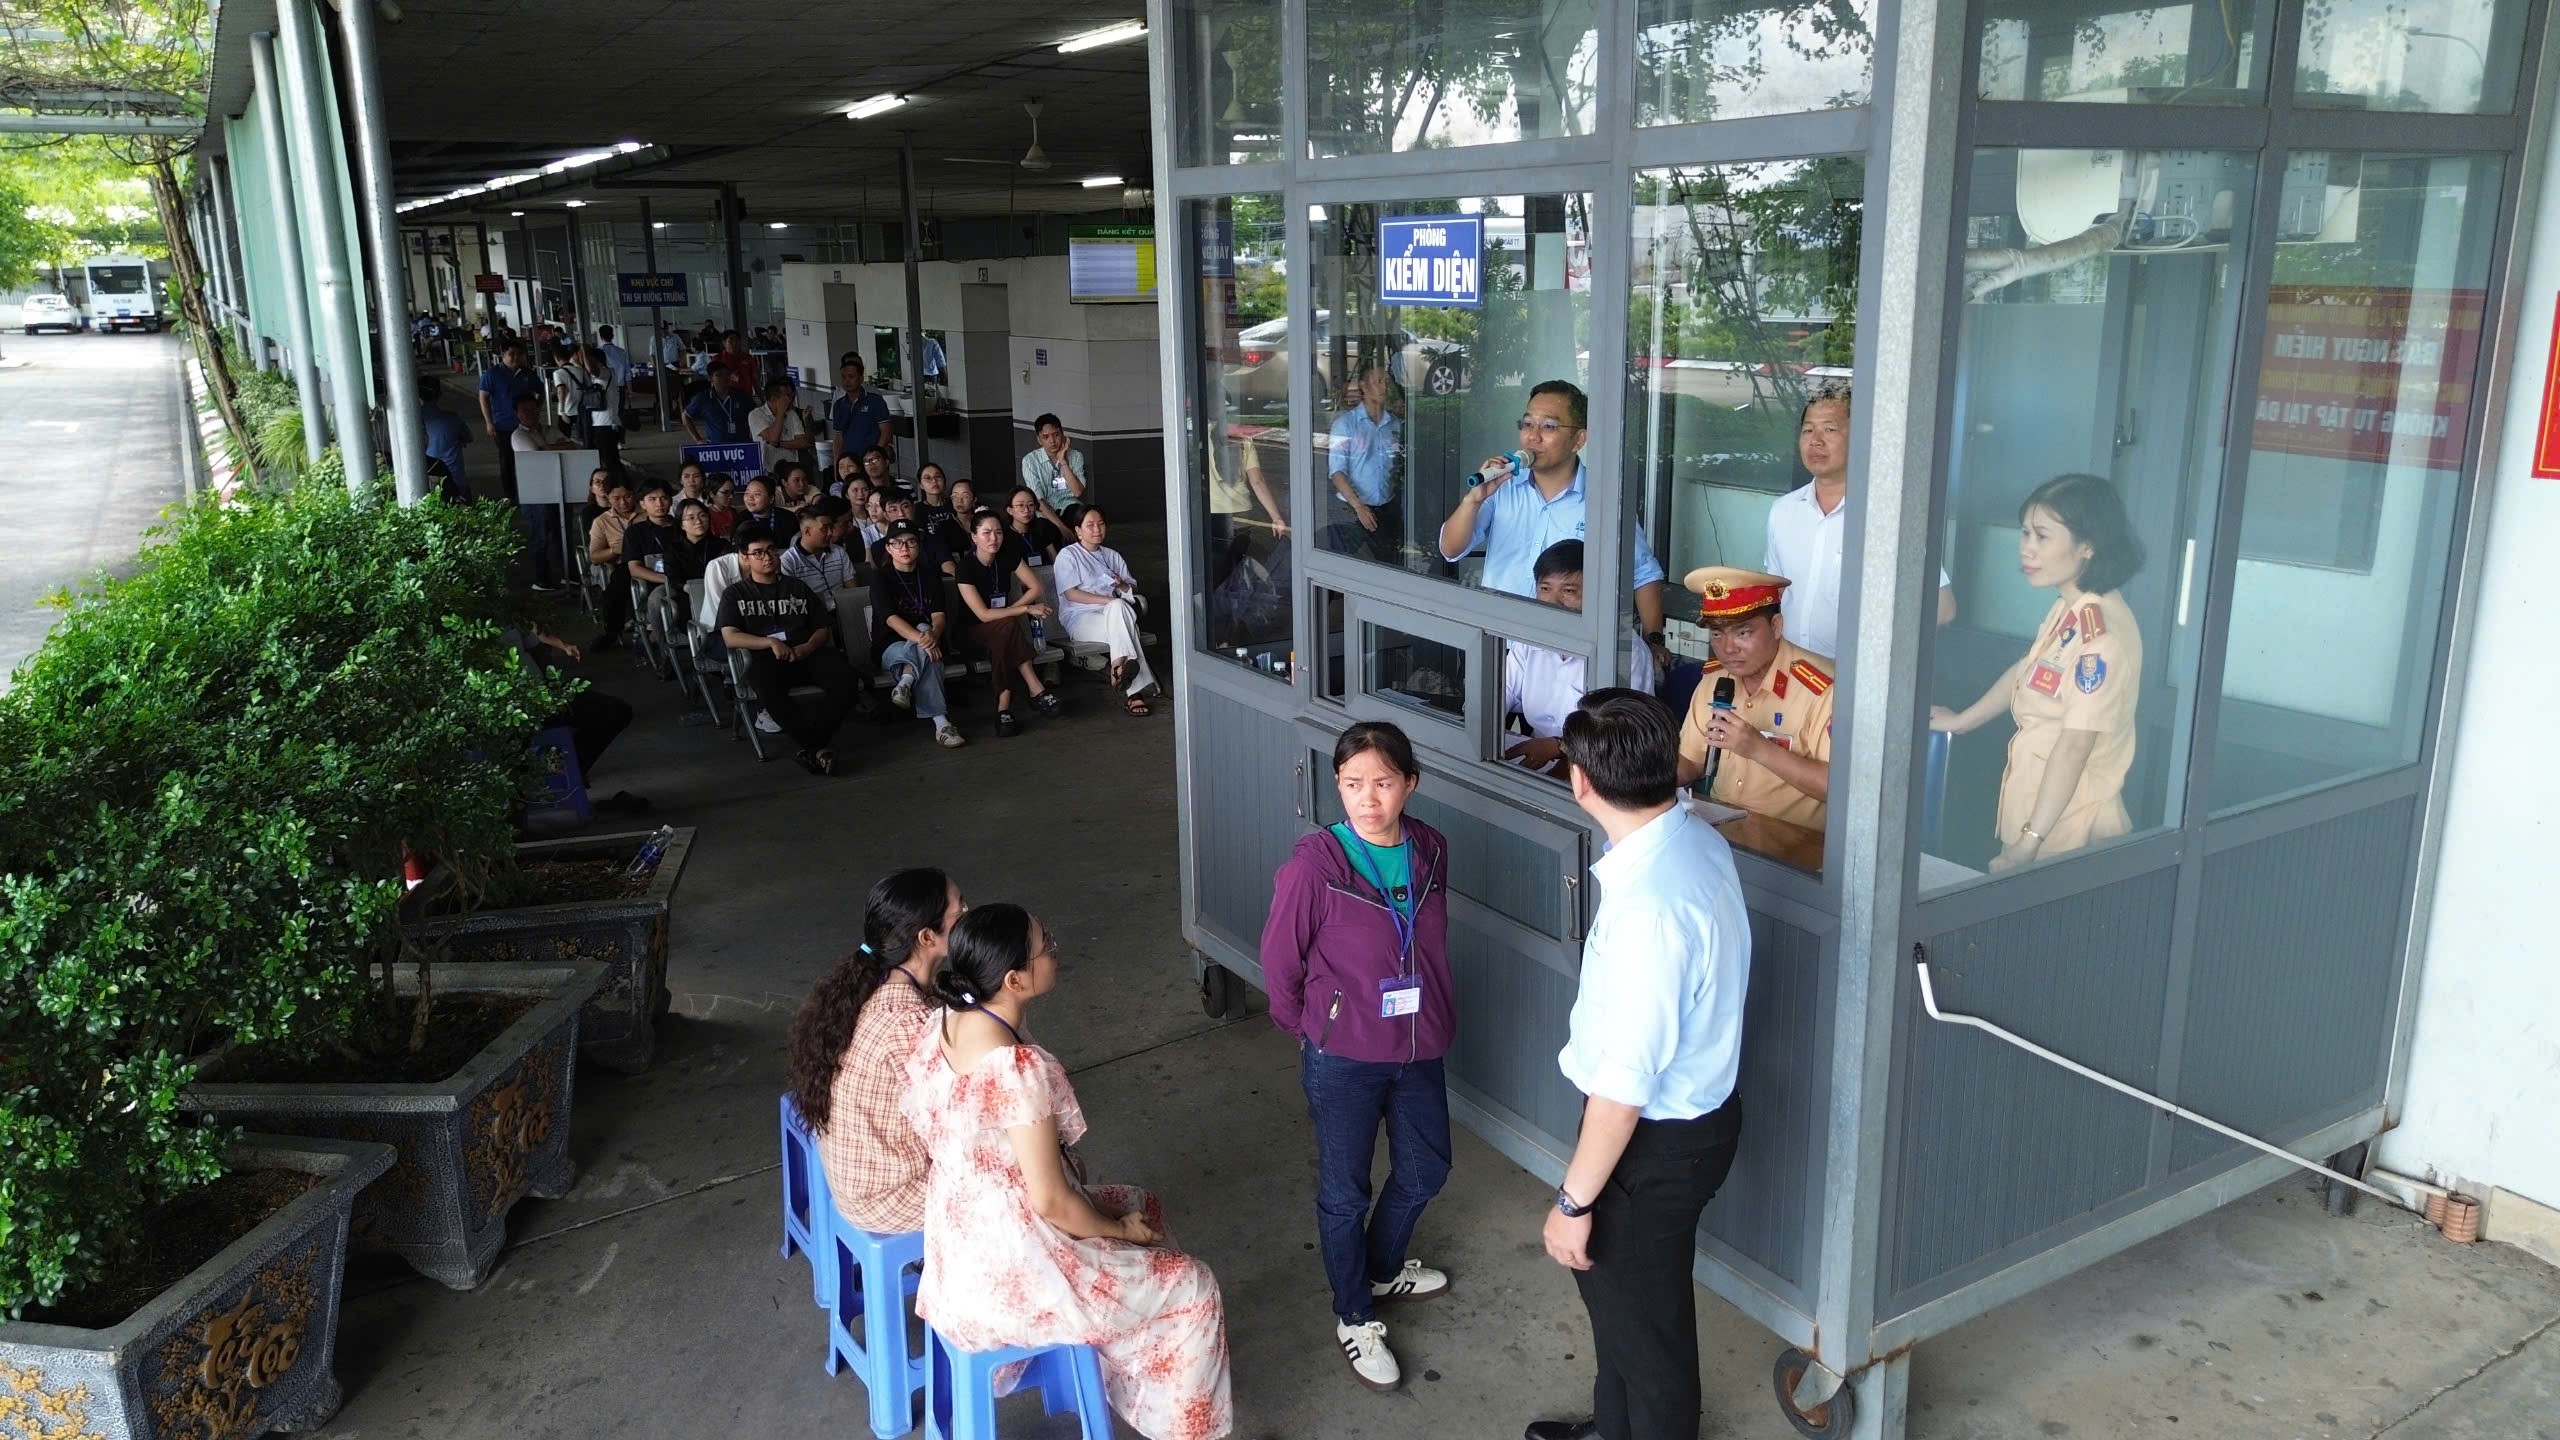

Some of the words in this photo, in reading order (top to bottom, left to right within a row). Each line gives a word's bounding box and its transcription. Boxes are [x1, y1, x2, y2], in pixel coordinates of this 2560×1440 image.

[1413, 224, 1446, 247] PHÒNG
[1385, 243, 1429, 292] KIỂM
[1433, 249, 1475, 299] DIỆN
[631, 278, 645, 287] KHU
[699, 450, 720, 462] KHU
[722, 447, 744, 463] VỰC
